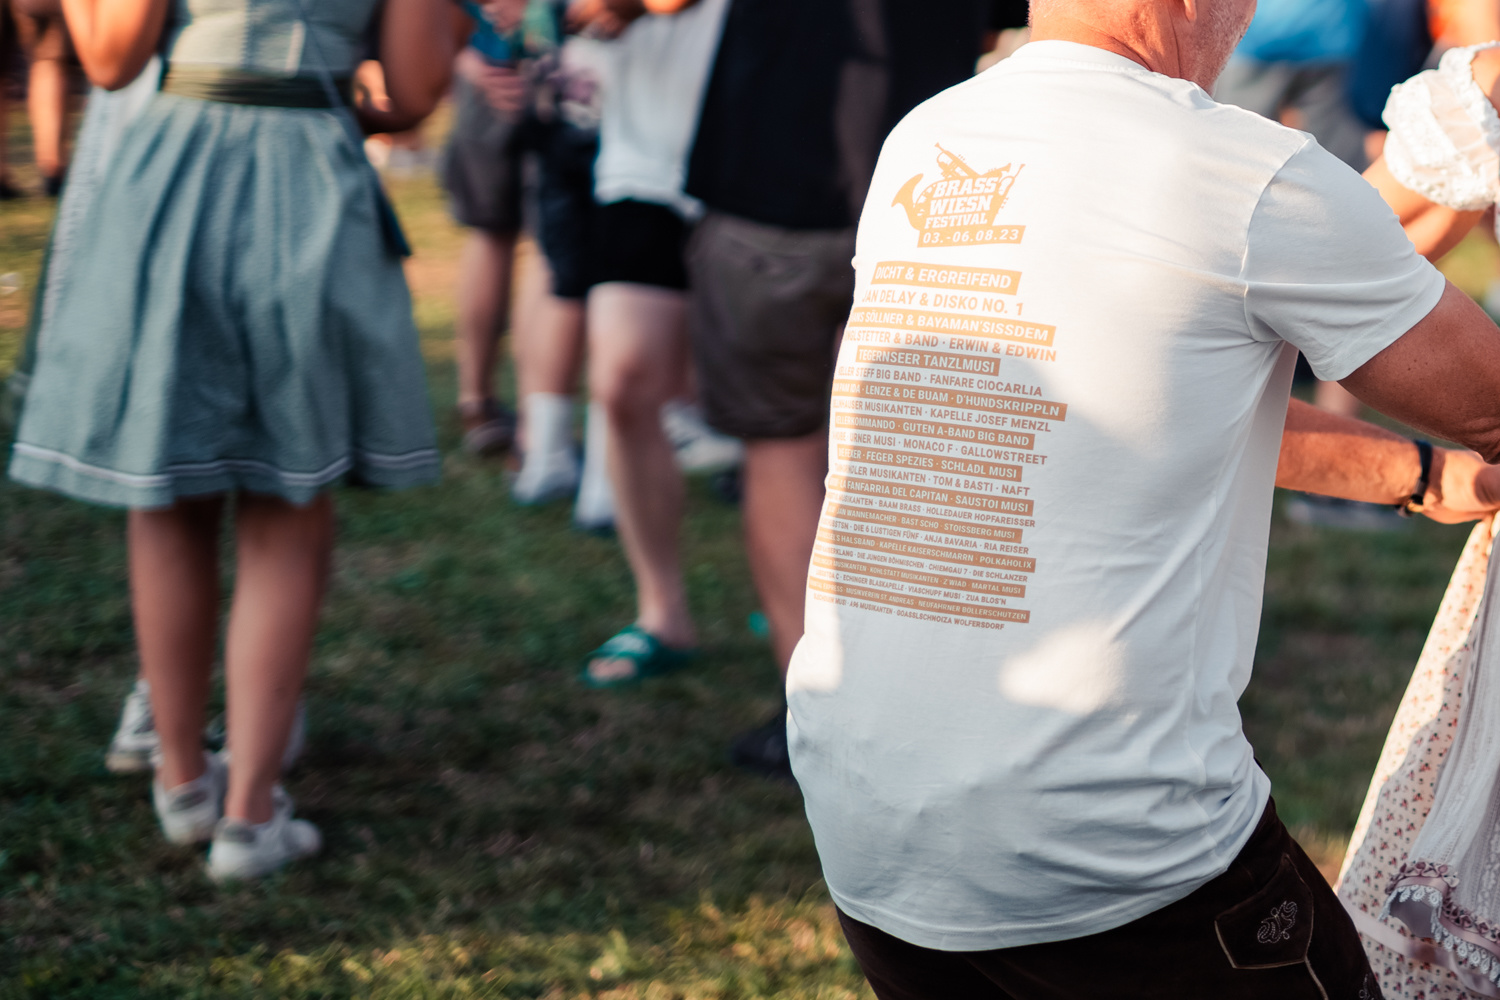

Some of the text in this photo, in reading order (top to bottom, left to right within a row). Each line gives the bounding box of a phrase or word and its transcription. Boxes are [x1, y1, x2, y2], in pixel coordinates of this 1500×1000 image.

[933, 177, 998, 198] BRASS
[930, 195, 993, 216] WIESN
[924, 212, 988, 230] FESTIVAL
[922, 229, 1019, 244] 03.-06.08.23
[874, 266, 1012, 289] DICHT & ERGREIFEND
[862, 290, 1024, 316] JAN DELAY & DISKO NO. 1
[865, 309, 904, 325] SÖLLNER
[906, 314, 915, 327] &
[917, 315, 1049, 342] BAYAMAN'SISSDEM
[858, 349, 995, 373] TEGERNSEER TANZLMUSI
[893, 332, 901, 345] &
[905, 333, 939, 348] BAND
[949, 338, 989, 353] ERWIN
[992, 342, 1001, 354] &
[1005, 344, 1057, 362] EDWIN
[855, 367, 875, 379] STEFF
[876, 369, 891, 380] BIG
[894, 370, 922, 383] BAND
[930, 374, 975, 389] FANFARE
[977, 380, 1043, 397] CIOCARLIA
[865, 385, 892, 397] LENZE
[894, 388, 901, 398] &
[902, 388, 916, 400] DE
[918, 390, 949, 403] BUAM
[956, 394, 1060, 417] D'HUNDSKRIPPLN
[864, 401, 923, 417] MUSIKANTEN
[930, 408, 973, 422] KAPELLE
[975, 413, 1008, 427] JOSEF
[1010, 418, 1052, 433] MENZL
[902, 422, 935, 435] GUTEN
[937, 426, 976, 440] A-BAND
[978, 430, 996, 442] BIG
[998, 434, 1030, 447] BAND
[874, 434, 896, 447] MUSI
[904, 438, 945, 452] MONACO
[947, 444, 954, 453] F
[960, 445, 1048, 465] GALLOWSTREET
[866, 451, 894, 463] FEGER
[896, 454, 934, 468] SPEZIES
[941, 460, 987, 475] SCHLADL
[989, 466, 1017, 479] MUSI
[870, 466, 927, 484] MUSIKANTEN
[933, 475, 953, 487] TOM
[955, 478, 962, 488] &
[964, 480, 994, 492] BASTI
[1001, 484, 1031, 497] NAFT
[847, 480, 890, 495] FANFARRIA
[892, 486, 908, 498] DEL
[910, 489, 949, 503] CAPITAN
[955, 495, 999, 510] SAUSTOI
[1001, 501, 1029, 513] MUSI
[847, 508, 897, 523] WANNEMACHER
[901, 516, 919, 526] BAST
[920, 519, 940, 530] SCHO
[944, 522, 992, 537] STOISSBERG
[994, 529, 1016, 540] MUSI
[878, 498, 899, 510] BAAM
[900, 502, 922, 513] BRASS
[926, 506, 973, 520] HOLLEDAUER
[974, 513, 1036, 528] HOPFAREISSER
[841, 534, 876, 548] HALSBAND
[879, 541, 907, 553] KAPELLE
[908, 546, 974, 562] KAISERSCHMARRN
[980, 556, 1032, 569] POLKAHOLIX
[853, 523, 865, 533] DIE
[865, 525, 870, 534] 6
[870, 526, 901, 538] LUSTIGEN
[902, 530, 920, 540] FÜNF
[924, 534, 943, 545] ANJA
[944, 537, 978, 549] BAVARIA
[984, 542, 999, 552] RIA
[1000, 545, 1030, 556] REISER
[857, 552, 866, 560] DIE
[866, 553, 888, 564] JUNGEN
[928, 562, 962, 575] CHIEMGAU
[964, 567, 968, 575] 7
[972, 570, 984, 578] DIE
[985, 572, 1028, 583] SCHLANZER
[843, 574, 868, 586] ECHINGER
[868, 578, 905, 592] BLASKAPELLE
[943, 590, 961, 600] MUSI
[966, 593, 980, 603] ZUA
[901, 570, 939, 585] MUSIKANTEN
[971, 582, 1001, 593] MARTAL
[1002, 586, 1021, 595] MUSI
[846, 586, 880, 600] MUSIKVEREIN
[888, 594, 915, 606] ANDREAS
[918, 599, 961, 613] NEUFAHRNER
[860, 602, 893, 615] MUSIKANTEN
[954, 618, 1005, 631] WOLFERSDORF
